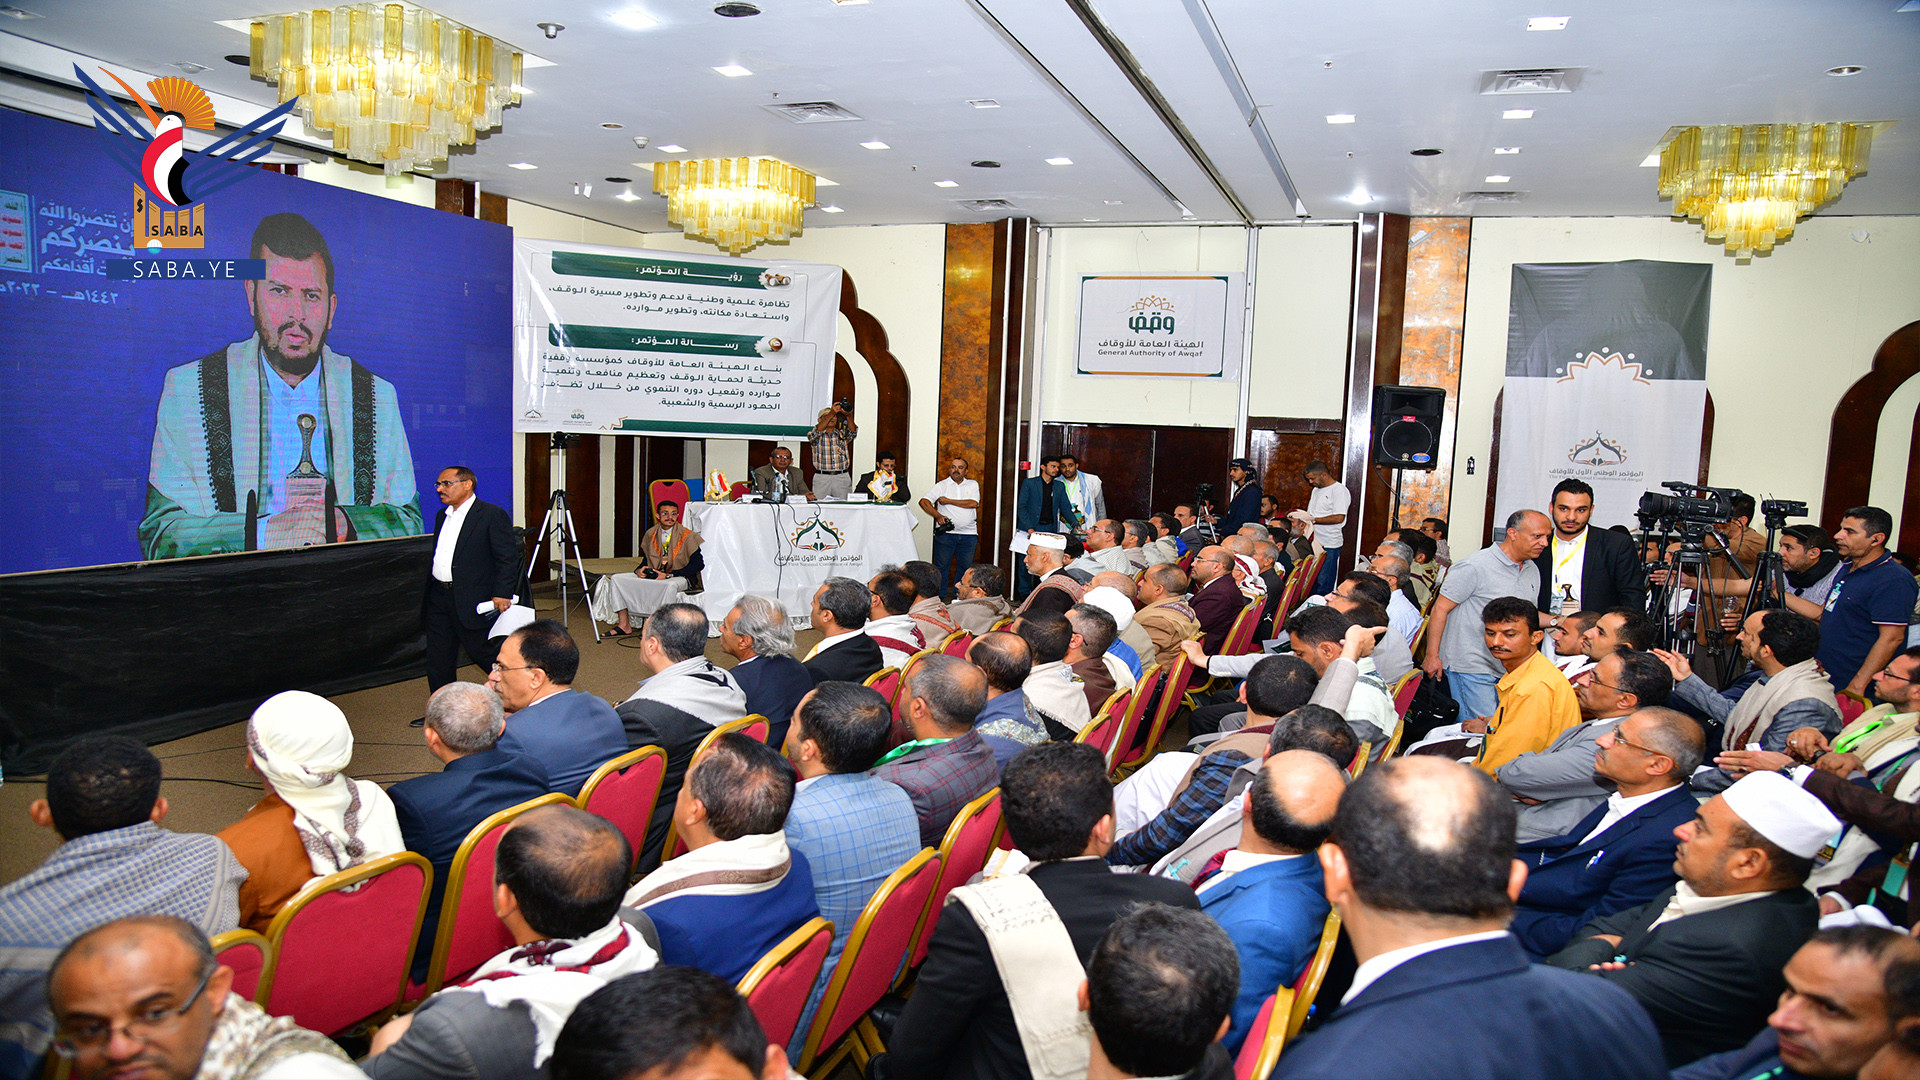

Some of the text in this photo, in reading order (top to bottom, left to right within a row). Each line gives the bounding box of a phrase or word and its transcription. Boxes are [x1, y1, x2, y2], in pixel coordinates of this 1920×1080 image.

[590, 286, 622, 297] مسيرة
[624, 290, 657, 300] وتطوير
[659, 292, 684, 301] لدعم
[687, 293, 724, 304] وطنية
[727, 296, 756, 306] علمية
[759, 298, 790, 308] تظاهرة
[665, 306, 698, 316] وتطوير
[735, 310, 790, 322] واستعادة
[680, 337, 739, 351] رسالة
[1098, 338, 1204, 350] الهيئة العامة للأوقاف
[1129, 349, 1165, 358] Authority
[1178, 350, 1204, 358] Awqaf
[627, 358, 665, 368] للأوقاف
[668, 359, 704, 369] العامة
[708, 361, 750, 372] الهيئة
[754, 364, 782, 375] بناء
[542, 365, 782, 387] حديثة لحماية الوقف وتعظيم منافعه وتنمية
[587, 382, 622, 391] خلال
[626, 383, 640, 392] من
[644, 384, 680, 395] التنموي
[684, 387, 704, 396] دوره
[707, 387, 745, 397] وتفعيل
[748, 389, 781, 399] موارده
[708, 399, 745, 410] الرسمية
[747, 402, 780, 412] الجهود
